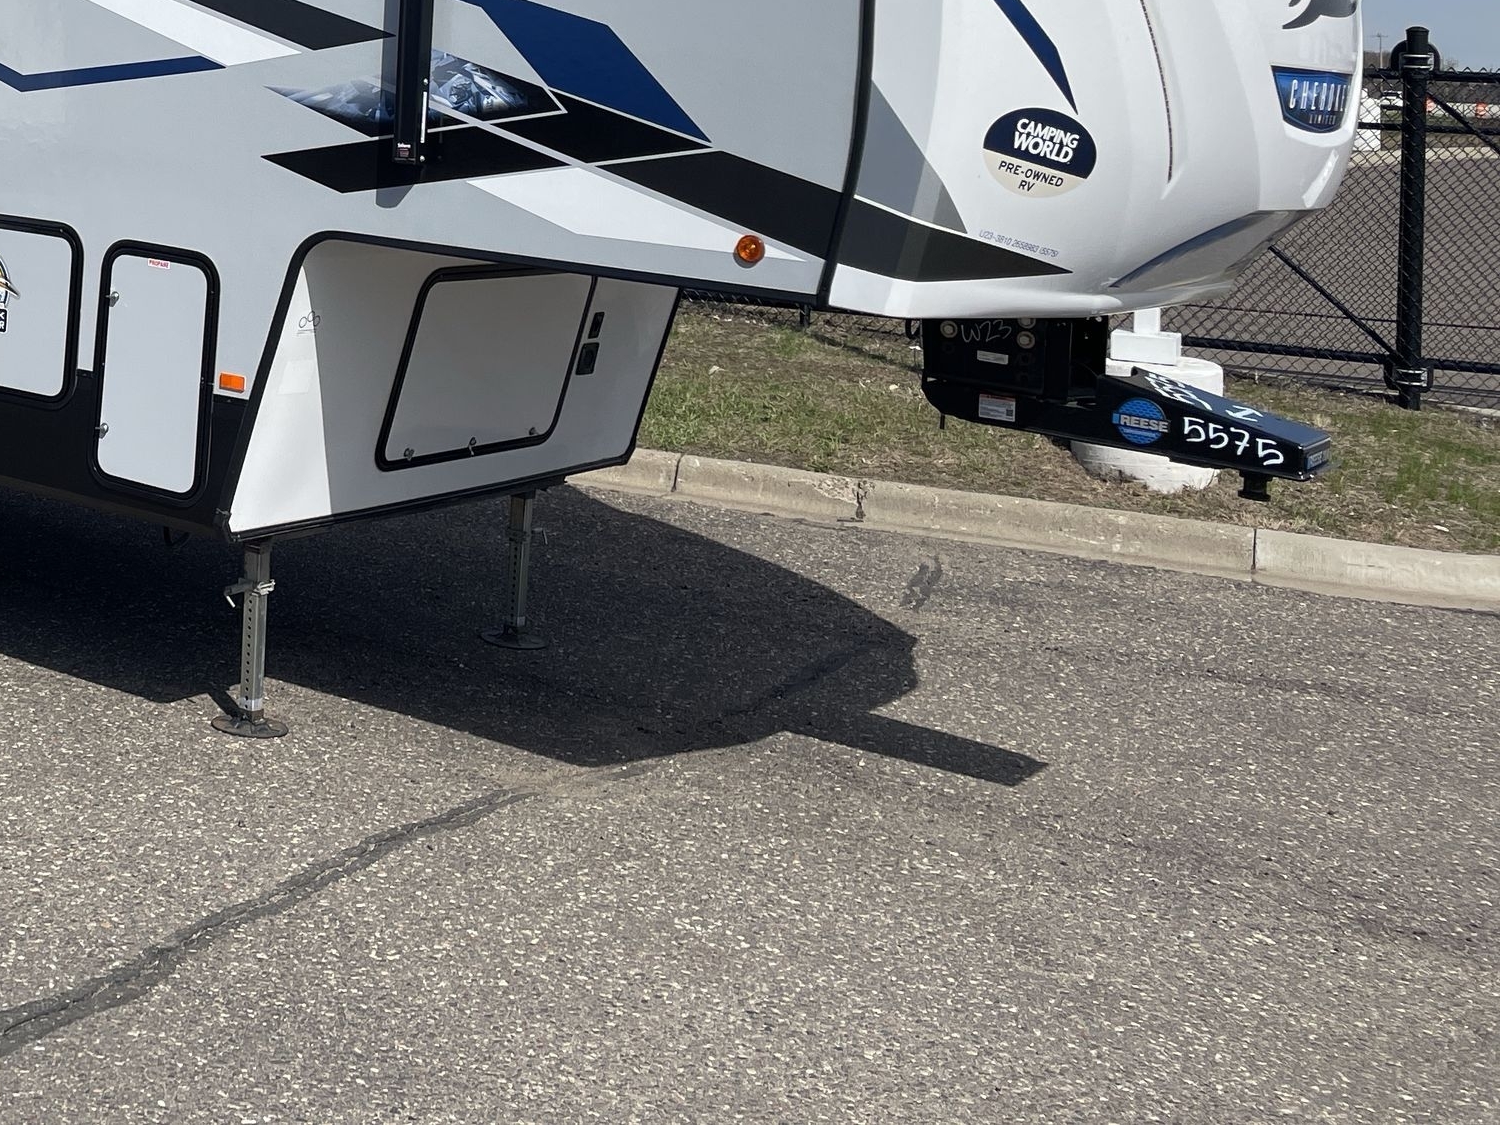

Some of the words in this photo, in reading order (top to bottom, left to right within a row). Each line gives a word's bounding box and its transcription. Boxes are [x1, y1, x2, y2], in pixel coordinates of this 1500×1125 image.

[1013, 131, 1074, 164] WORLD
[1016, 118, 1080, 149] CAMPING
[998, 160, 1064, 187] PRE-OWNED
[1018, 179, 1036, 192] RV
[1120, 414, 1169, 433] REESE
[1183, 416, 1284, 466] 5575
